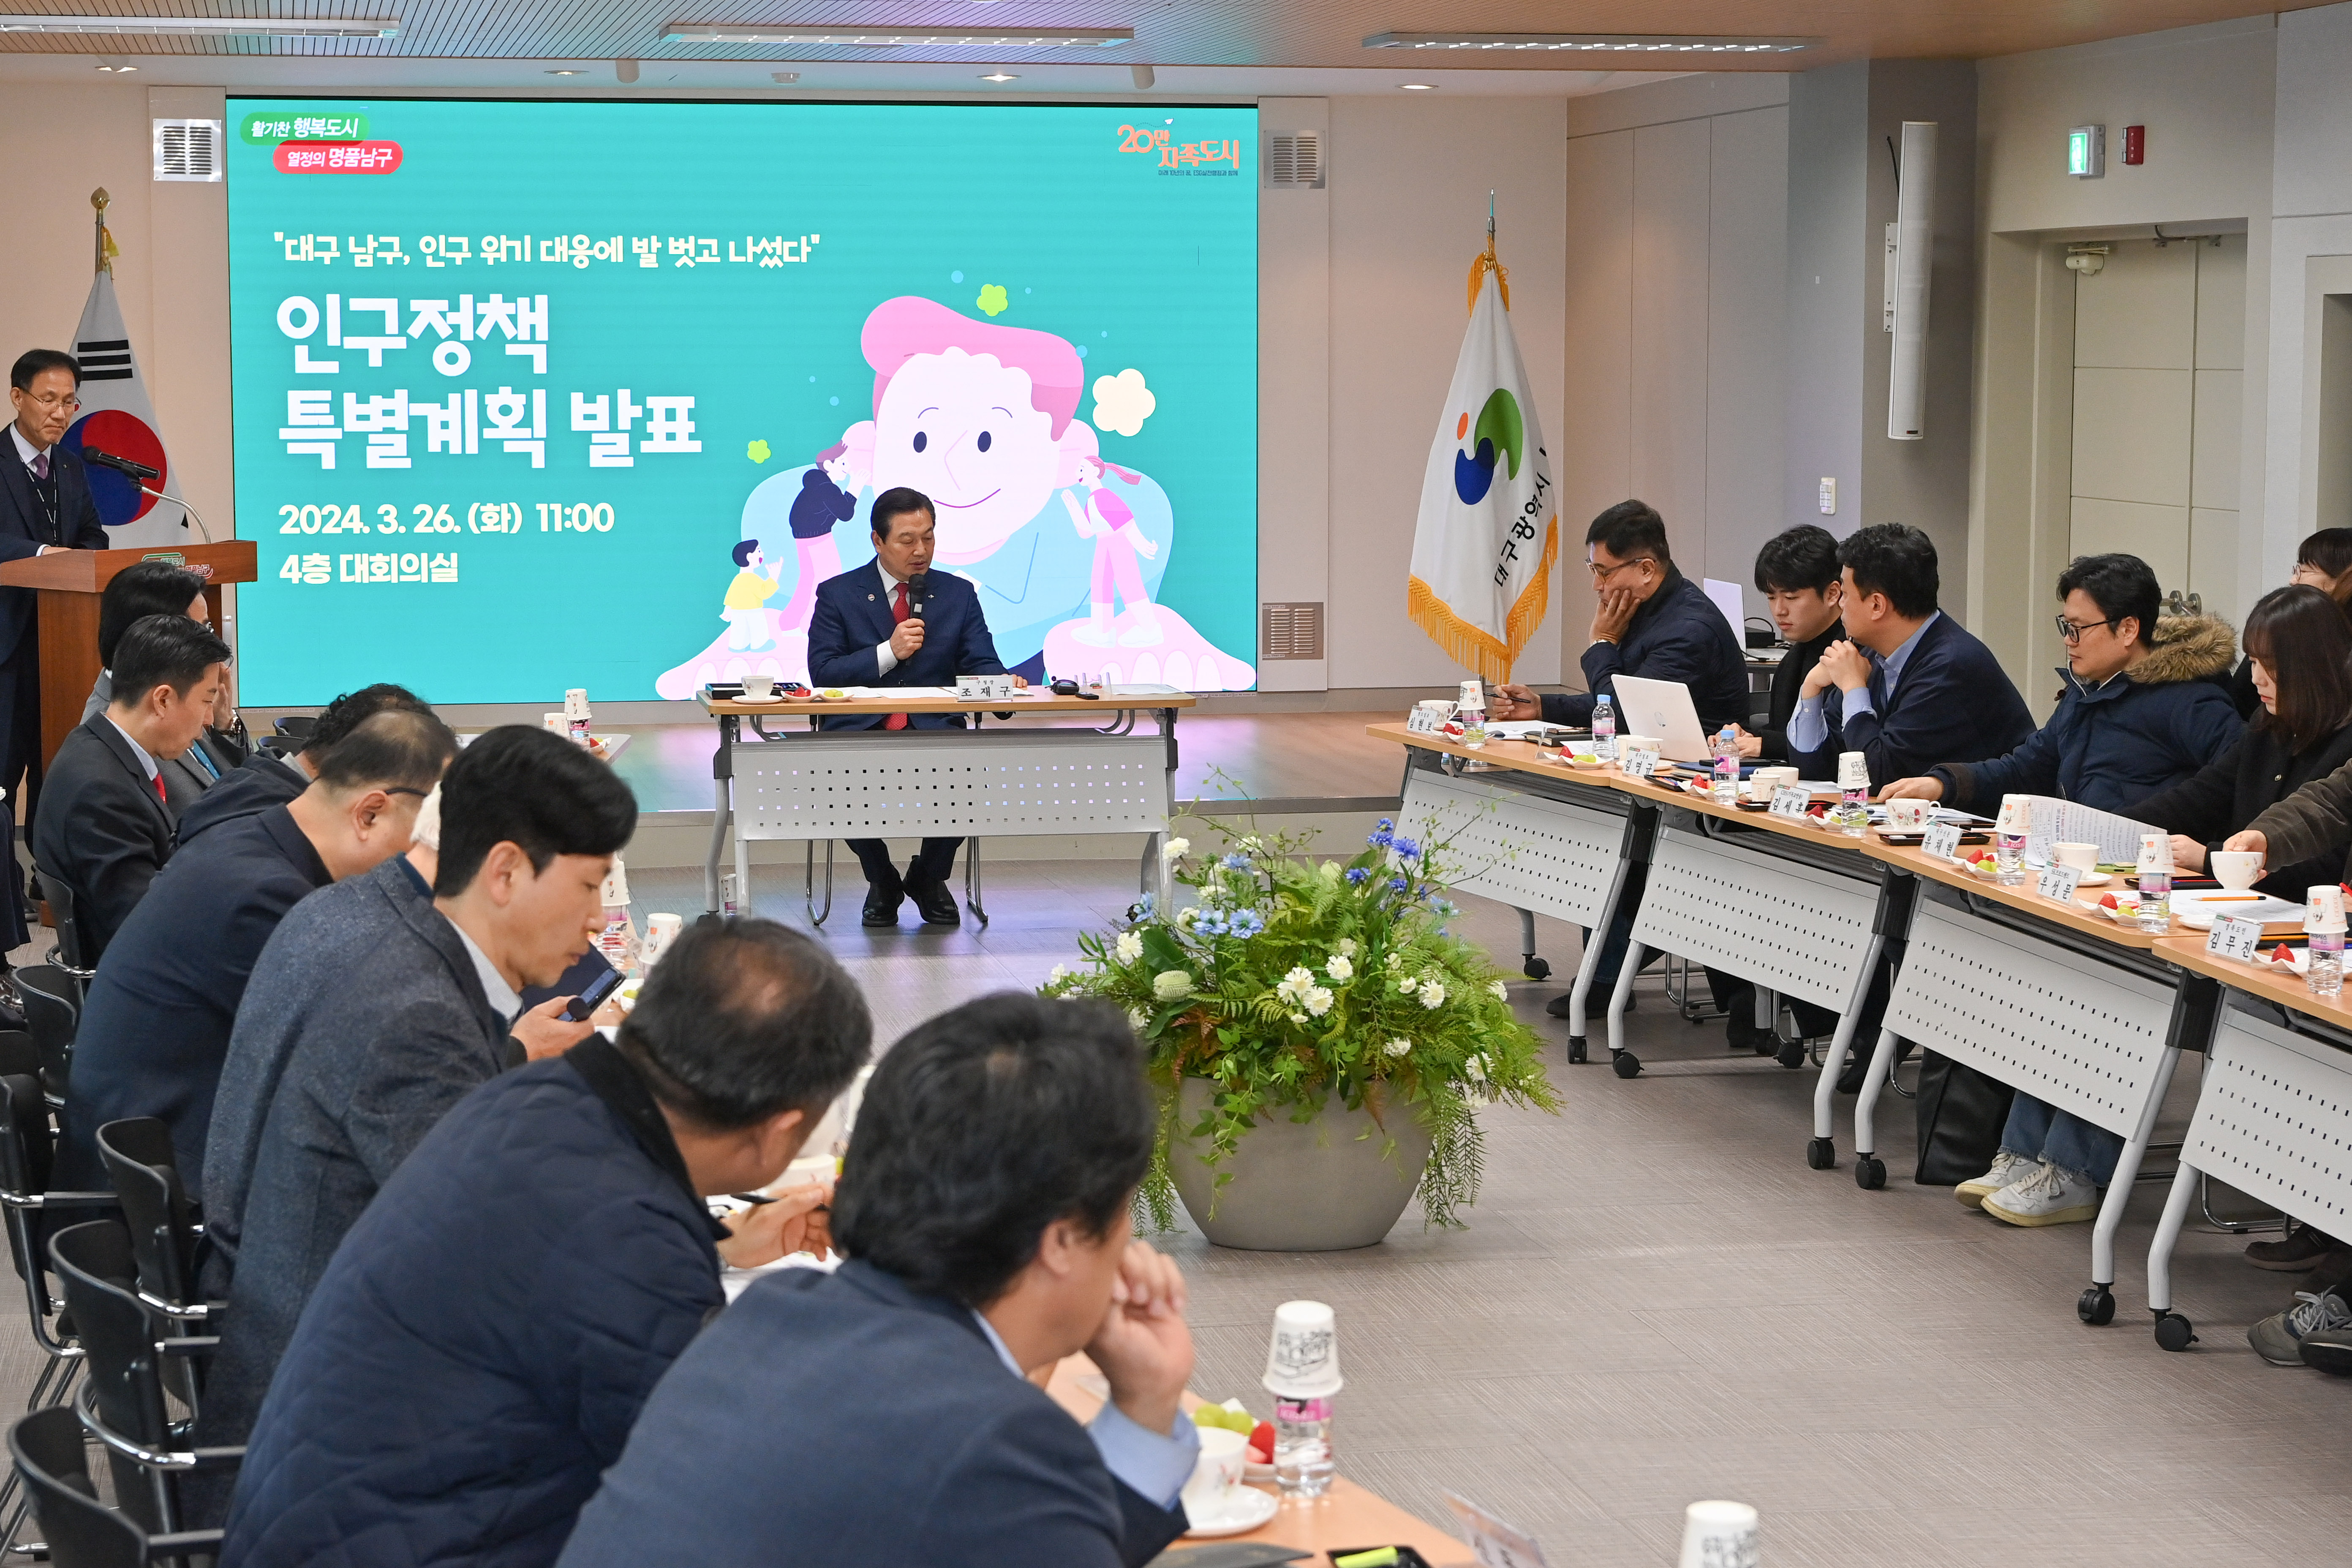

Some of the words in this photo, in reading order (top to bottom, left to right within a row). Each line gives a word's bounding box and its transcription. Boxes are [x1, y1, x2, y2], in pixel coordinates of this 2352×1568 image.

[251, 121, 291, 137] 활기찬
[294, 117, 359, 138] 행복도시
[288, 151, 326, 168] 열정의
[329, 147, 393, 168] 명품남구
[1118, 125, 1170, 153] 20만
[1158, 140, 1239, 169] 자족도시
[275, 232, 340, 264] "대구
[349, 234, 410, 267] 남구,
[419, 235, 472, 267] 인구
[481, 235, 531, 265] 위기
[540, 234, 623, 269] 대응에
[632, 236, 662, 268] 발
[669, 236, 721, 268] 벗고
[729, 234, 820, 269] 나섰다"
[277, 294, 548, 376] 인구정책
[279, 387, 547, 469] 특별계획
[571, 389, 702, 467] 발표
[279, 504, 370, 534] 2024.
[377, 504, 406, 534] 3.
[413, 504, 461, 534] 26.
[468, 503, 522, 534] (화)
[536, 503, 615, 532] 11:00
[280, 553, 332, 584] 4층
[340, 553, 458, 583] 대회의실
[961, 686, 1010, 697] 조재구
[1625, 759, 1652, 774] 김명규
[2040, 876, 2071, 899] 우성문
[2210, 931, 2252, 958] 김무진
